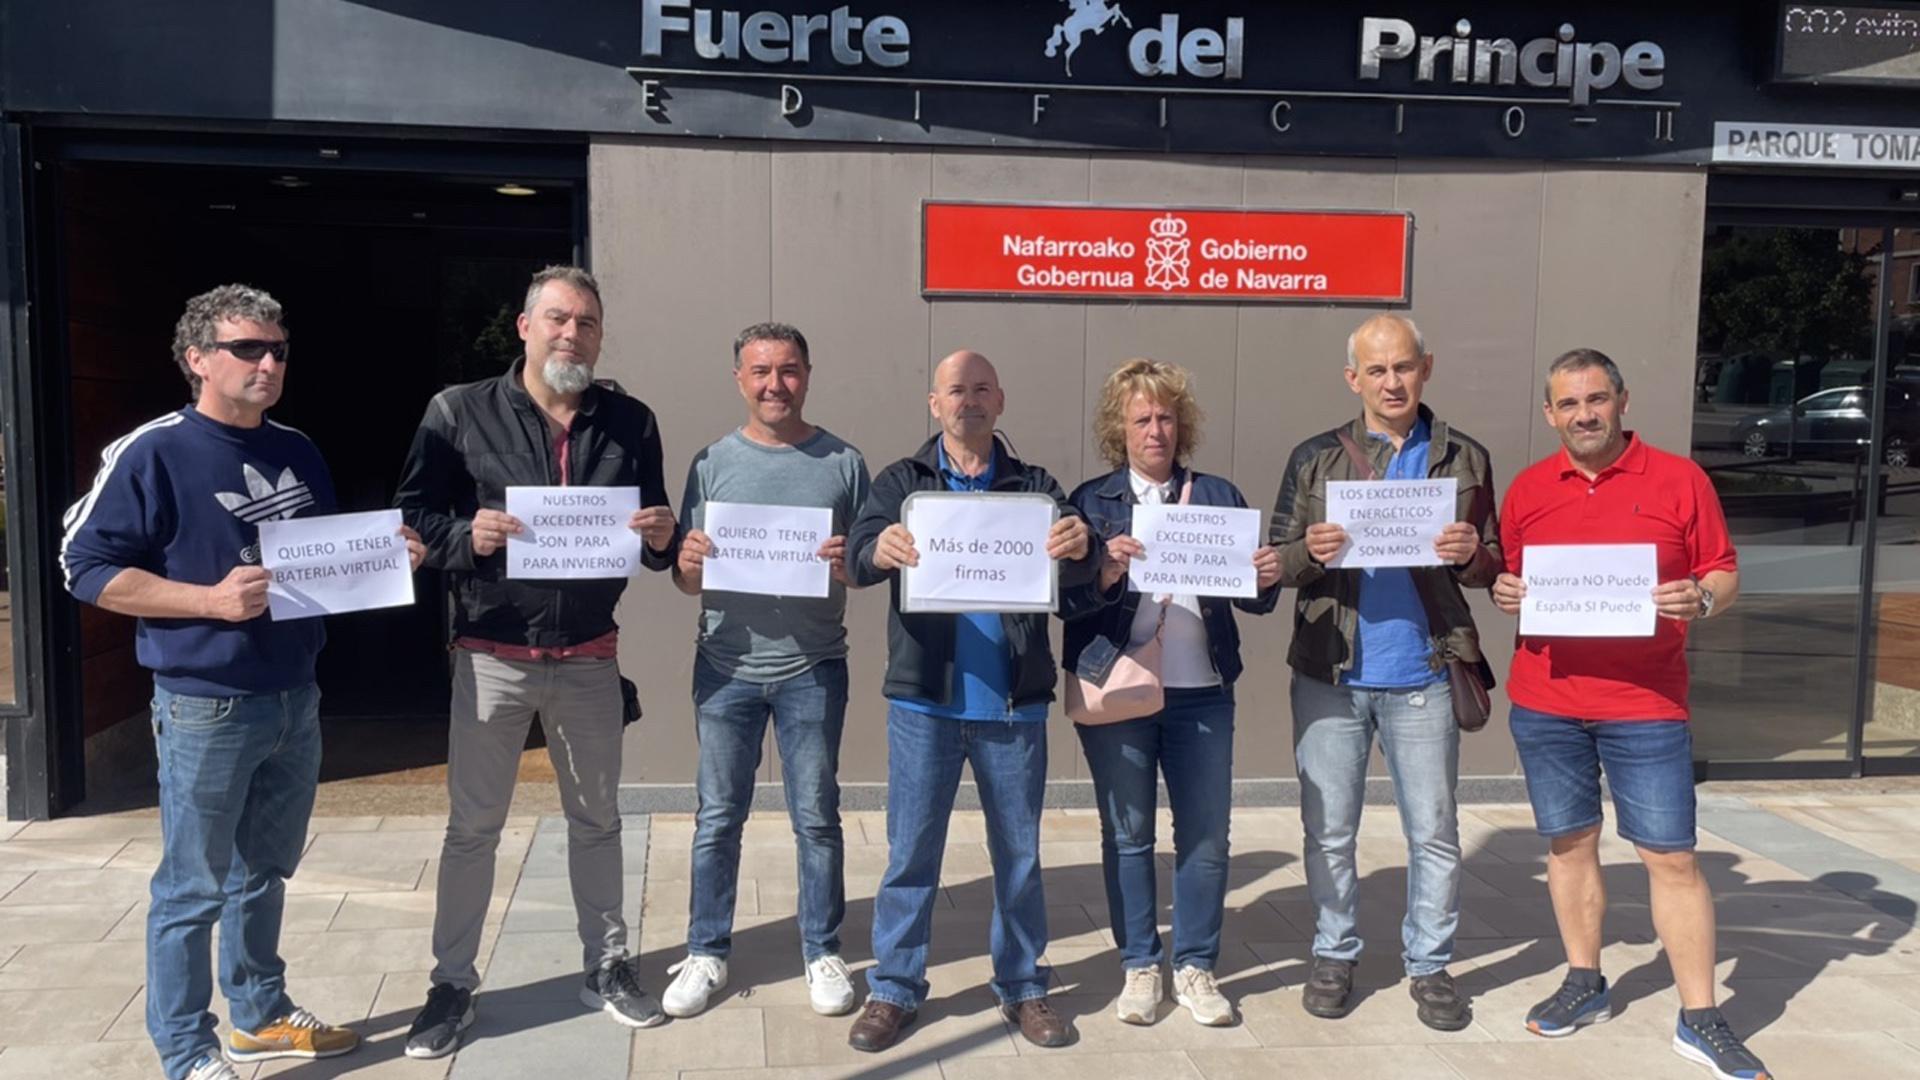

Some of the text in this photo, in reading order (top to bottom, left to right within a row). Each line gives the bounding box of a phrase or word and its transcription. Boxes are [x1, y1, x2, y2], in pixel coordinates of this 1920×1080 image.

[641, 0, 1665, 106] Fuerte del Principe
[1728, 130, 1836, 159] PARQUE
[1003, 235, 1135, 258] Nafarroako
[1200, 239, 1308, 261] Gobierno
[1017, 265, 1134, 288] Gobernua
[1199, 268, 1328, 290] de Navarra
[543, 495, 607, 506] NUESTROS
[1340, 486, 1442, 500] LOS EXCEDENTES
[1166, 512, 1227, 526] NUESTROS
[1350, 503, 1433, 519] ENERGÉTICOS
[533, 515, 616, 526] EXCEDENTES
[717, 526, 817, 542] QUIERO TENER
[1156, 530, 1236, 546] EXCEDENTES
[1363, 526, 1418, 538] SOLARES
[278, 542, 335, 561] QUIERO
[345, 535, 392, 552] TENER
[539, 536, 610, 548] SON PARA
[929, 537, 1034, 555] Más de 2000
[712, 547, 765, 560] BATERIA
[1359, 544, 1421, 557] SON MIOS
[523, 557, 626, 569] PARA INVIERNO
[1160, 552, 1227, 566] SON PARA
[276, 558, 399, 584] BATERIA VIRTUAL
[955, 564, 1006, 581] firmas
[1144, 572, 1242, 588] PARA INVIERNO
[1528, 574, 1650, 586] Navarra NO Puede
[1536, 600, 1581, 613] España
[1600, 600, 1642, 612] Puede
